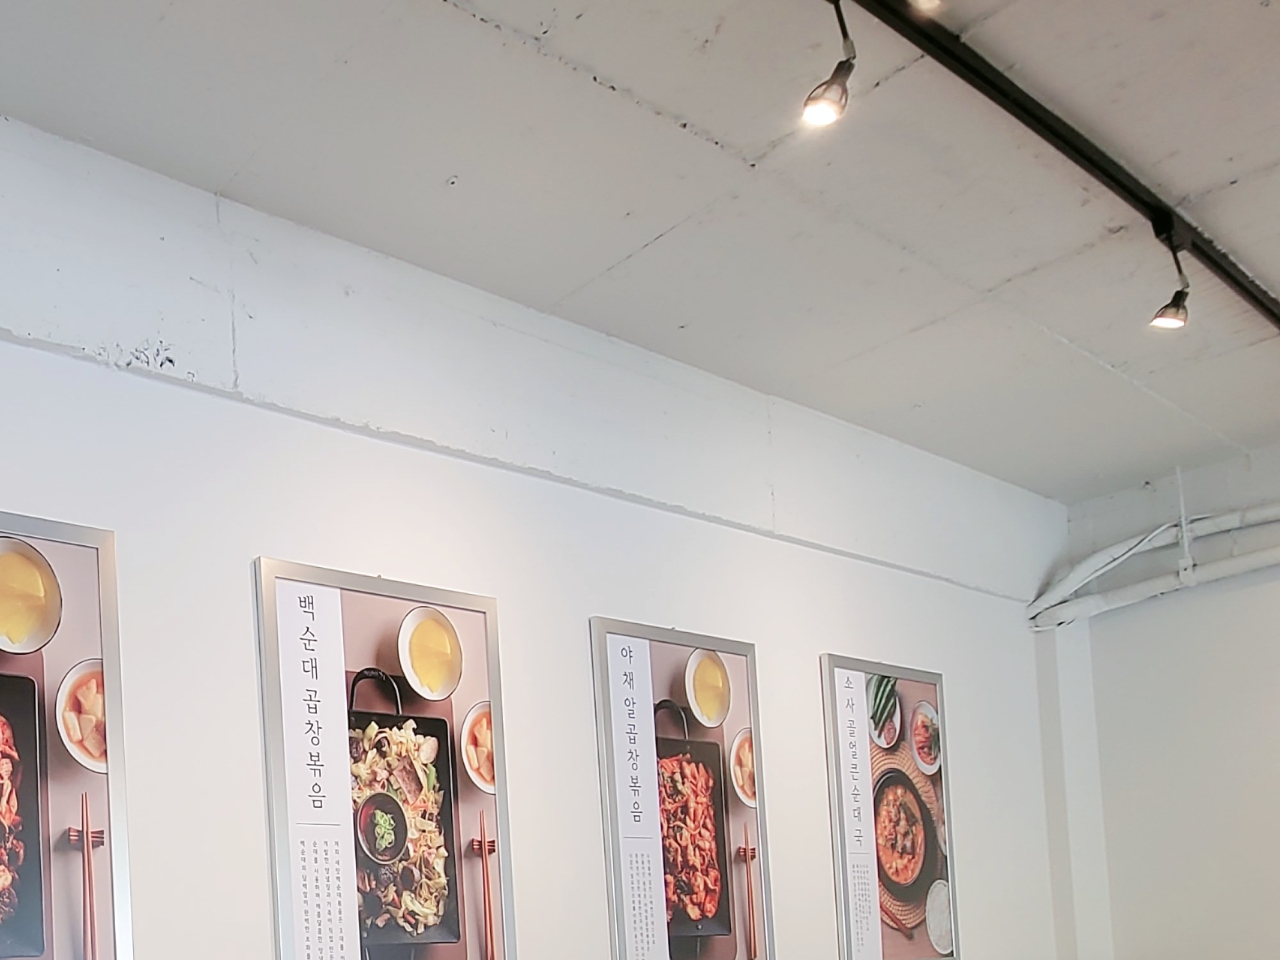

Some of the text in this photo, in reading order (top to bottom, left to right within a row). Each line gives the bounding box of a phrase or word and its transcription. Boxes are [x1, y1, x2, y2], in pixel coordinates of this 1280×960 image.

[298, 595, 326, 808] 백순대곱창볶음
[621, 646, 643, 822] 야채알곱창볶음
[844, 676, 864, 847] 소사골얼큰순대국
